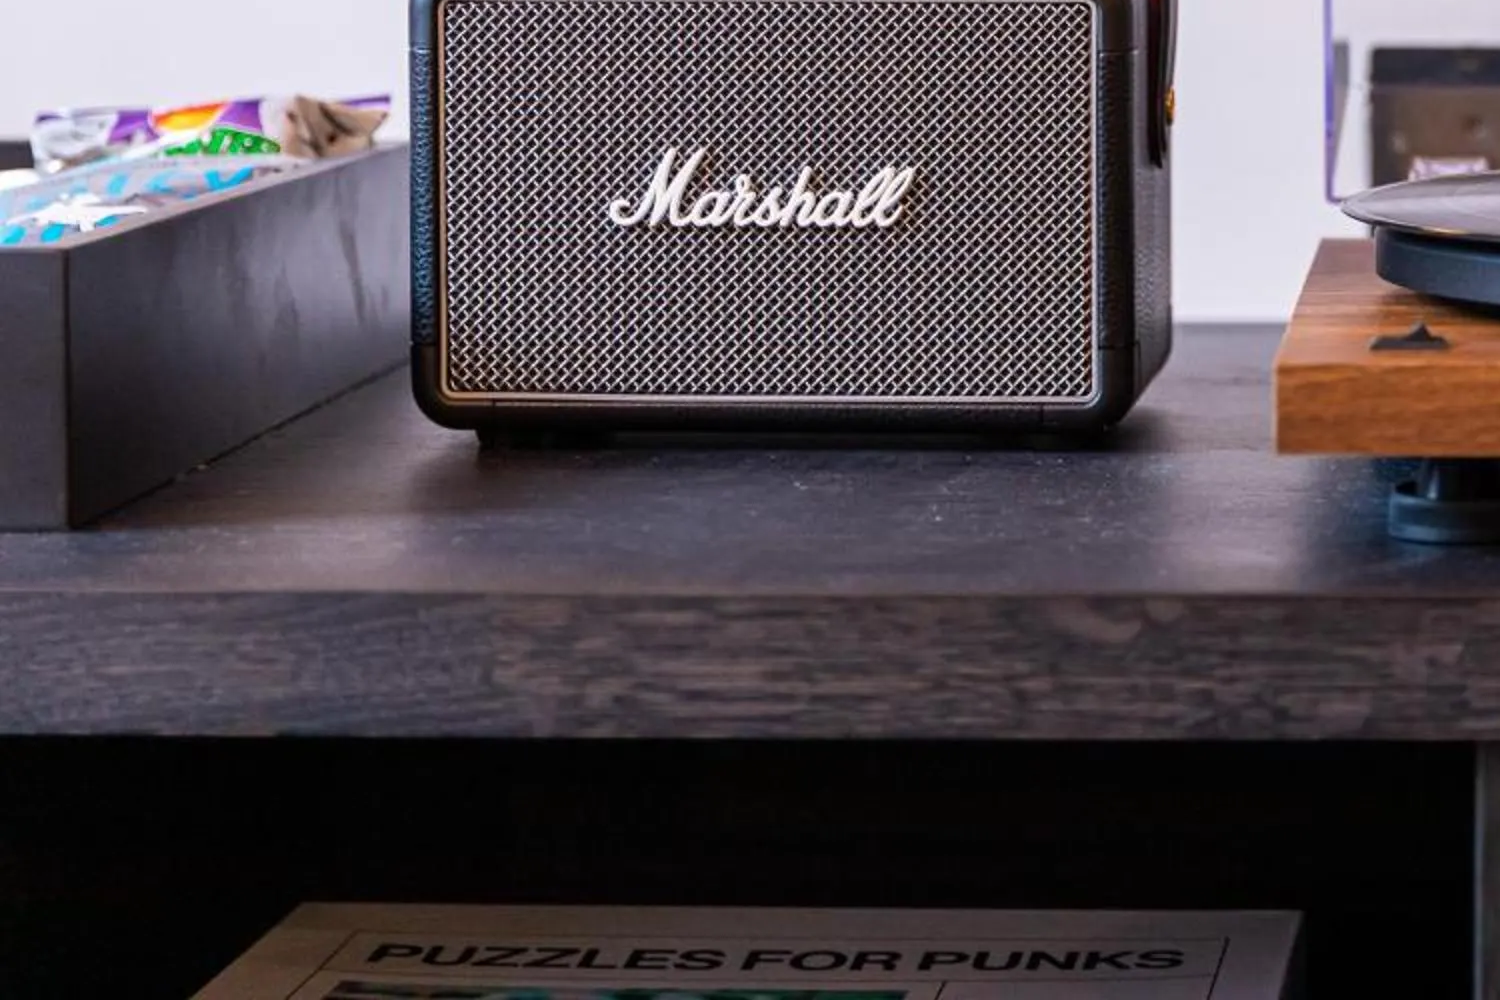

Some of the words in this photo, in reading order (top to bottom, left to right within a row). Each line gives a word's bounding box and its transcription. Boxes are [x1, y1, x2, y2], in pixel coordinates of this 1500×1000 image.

[609, 148, 914, 227] Marshall
[366, 943, 727, 970] PUZZLES
[740, 949, 903, 971] FOR
[917, 949, 1185, 971] PUNKS
